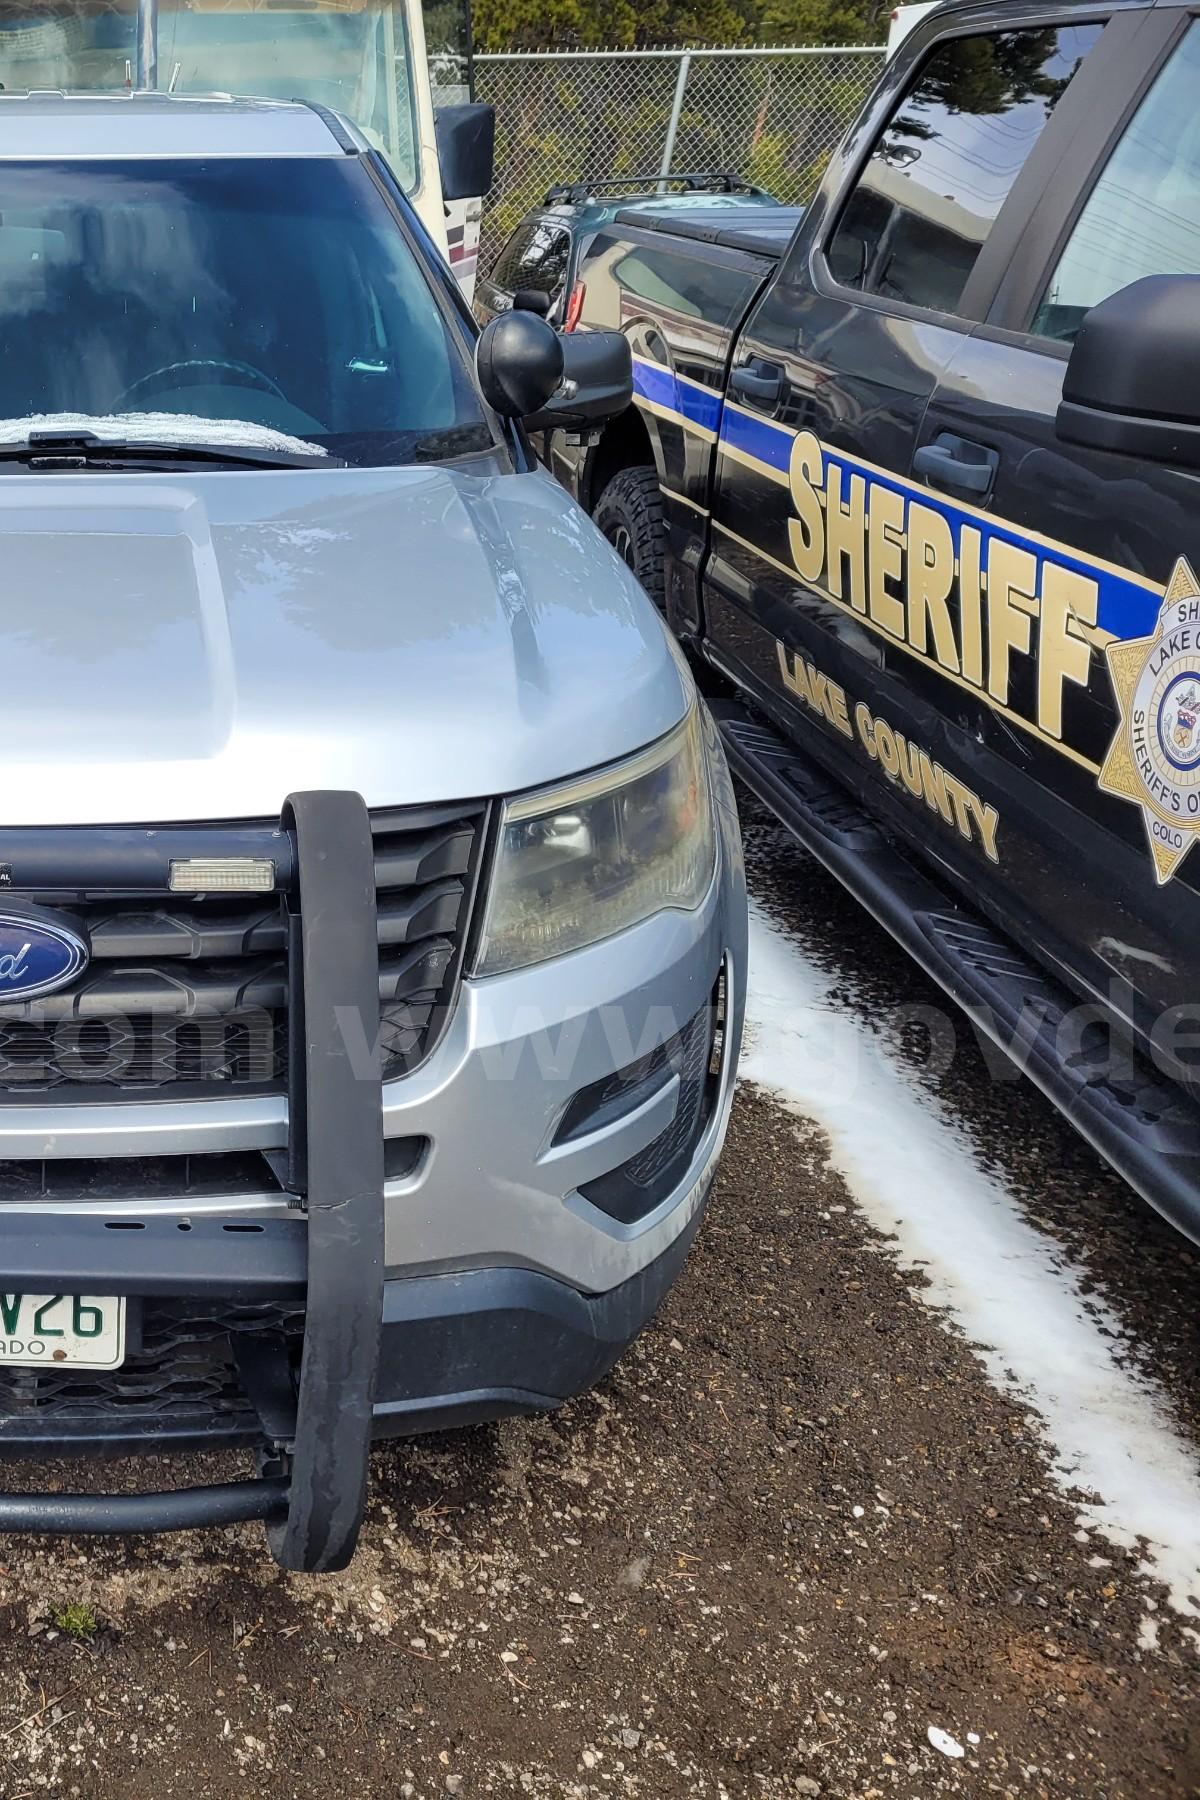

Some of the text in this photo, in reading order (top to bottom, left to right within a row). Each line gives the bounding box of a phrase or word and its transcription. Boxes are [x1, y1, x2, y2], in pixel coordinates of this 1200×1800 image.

[787, 431, 1099, 740] SHERIFF
[1149, 630, 1191, 677] LAKE
[775, 639, 999, 865] LAKE COUNTY
[1133, 710, 1181, 812] SHERIFF'S
[1153, 821, 1183, 849] COLO
